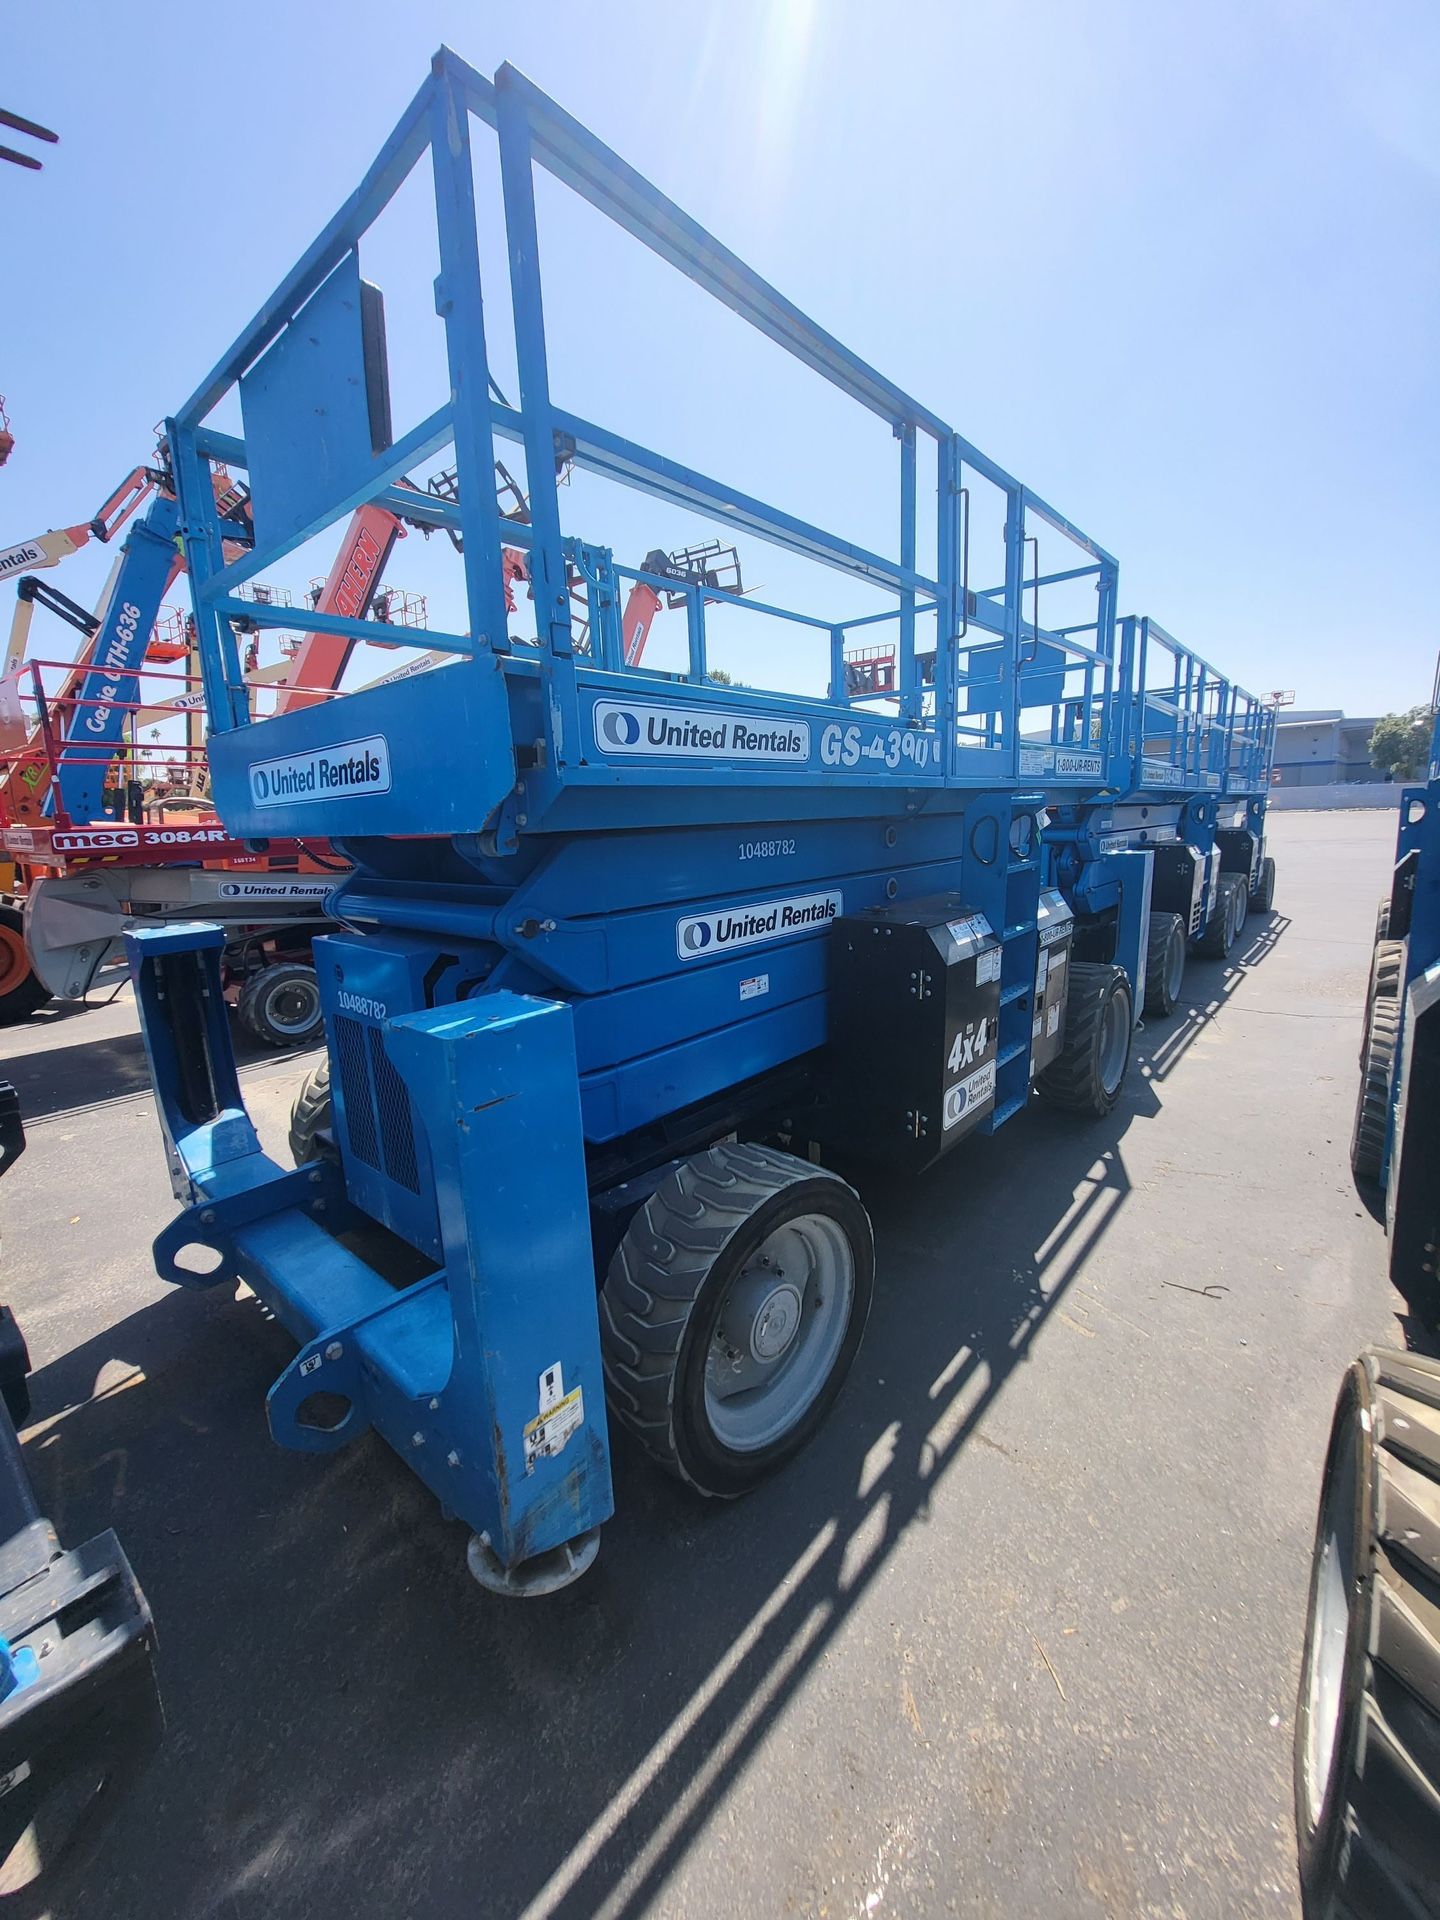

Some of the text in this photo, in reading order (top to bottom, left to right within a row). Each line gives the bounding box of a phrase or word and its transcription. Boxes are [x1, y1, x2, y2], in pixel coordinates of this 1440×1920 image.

[335, 527, 381, 618] AHERN
[86, 685, 117, 733] Geie
[647, 715, 801, 753] United Rentals
[270, 750, 380, 796] United Rentals
[54, 833, 137, 848] mec
[738, 839, 796, 860] 10488782
[244, 886, 333, 895] United Rentals
[716, 898, 837, 943] United Rentals
[337, 990, 387, 1020] 10488782
[947, 1017, 988, 1074] 4x4
[967, 1081, 993, 1107] Rentals
[968, 1067, 992, 1093] United
[543, 1397, 570, 1422] WARNING
